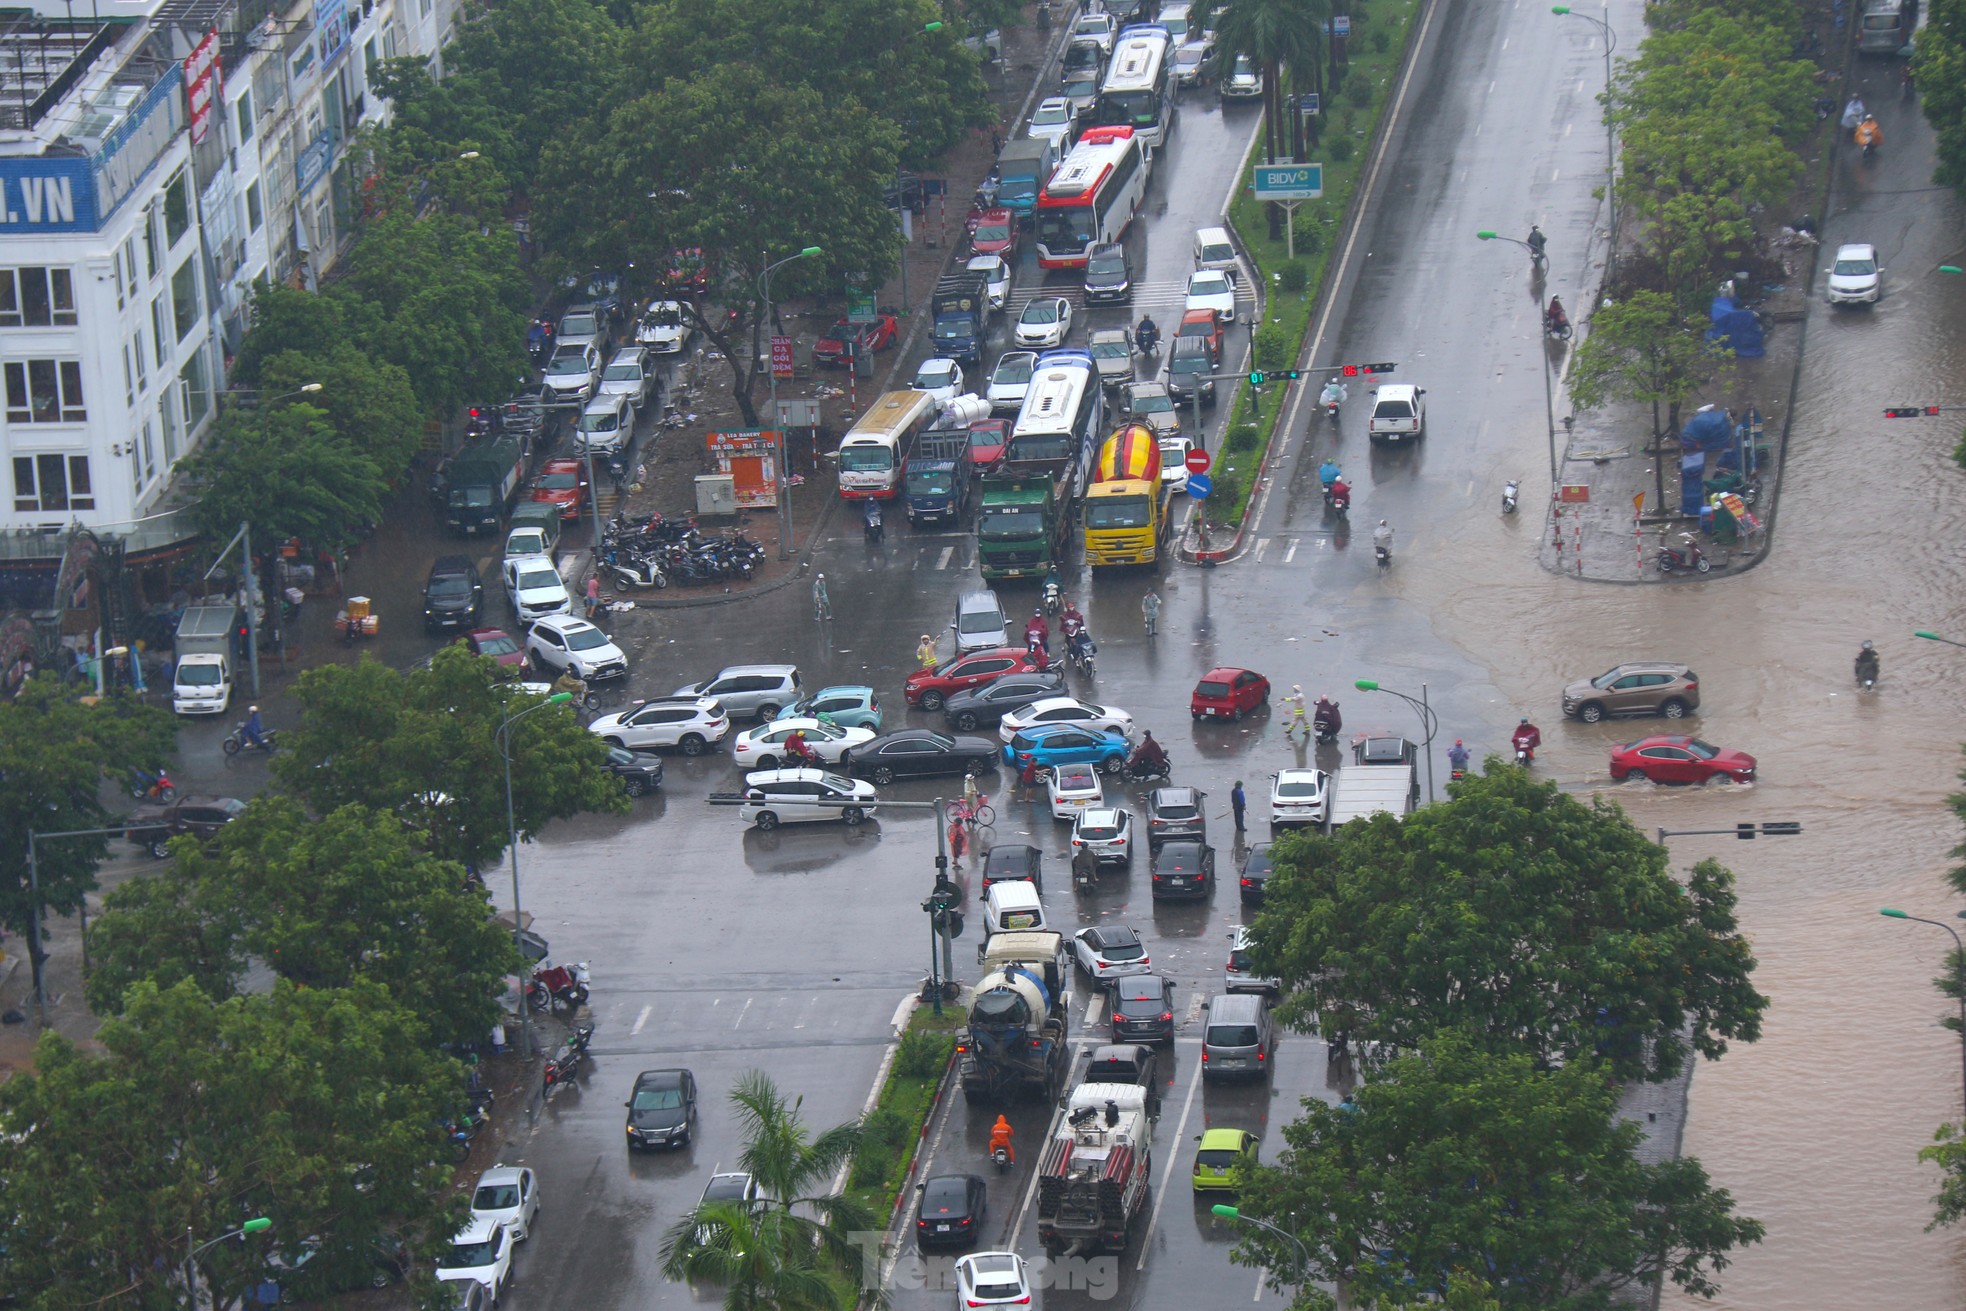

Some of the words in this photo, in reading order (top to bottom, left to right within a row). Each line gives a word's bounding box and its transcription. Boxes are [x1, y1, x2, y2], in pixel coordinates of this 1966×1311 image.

[1268, 172, 1298, 184] BIDV
[1343, 365, 1358, 377] 06
[1250, 372, 1263, 384] 01
